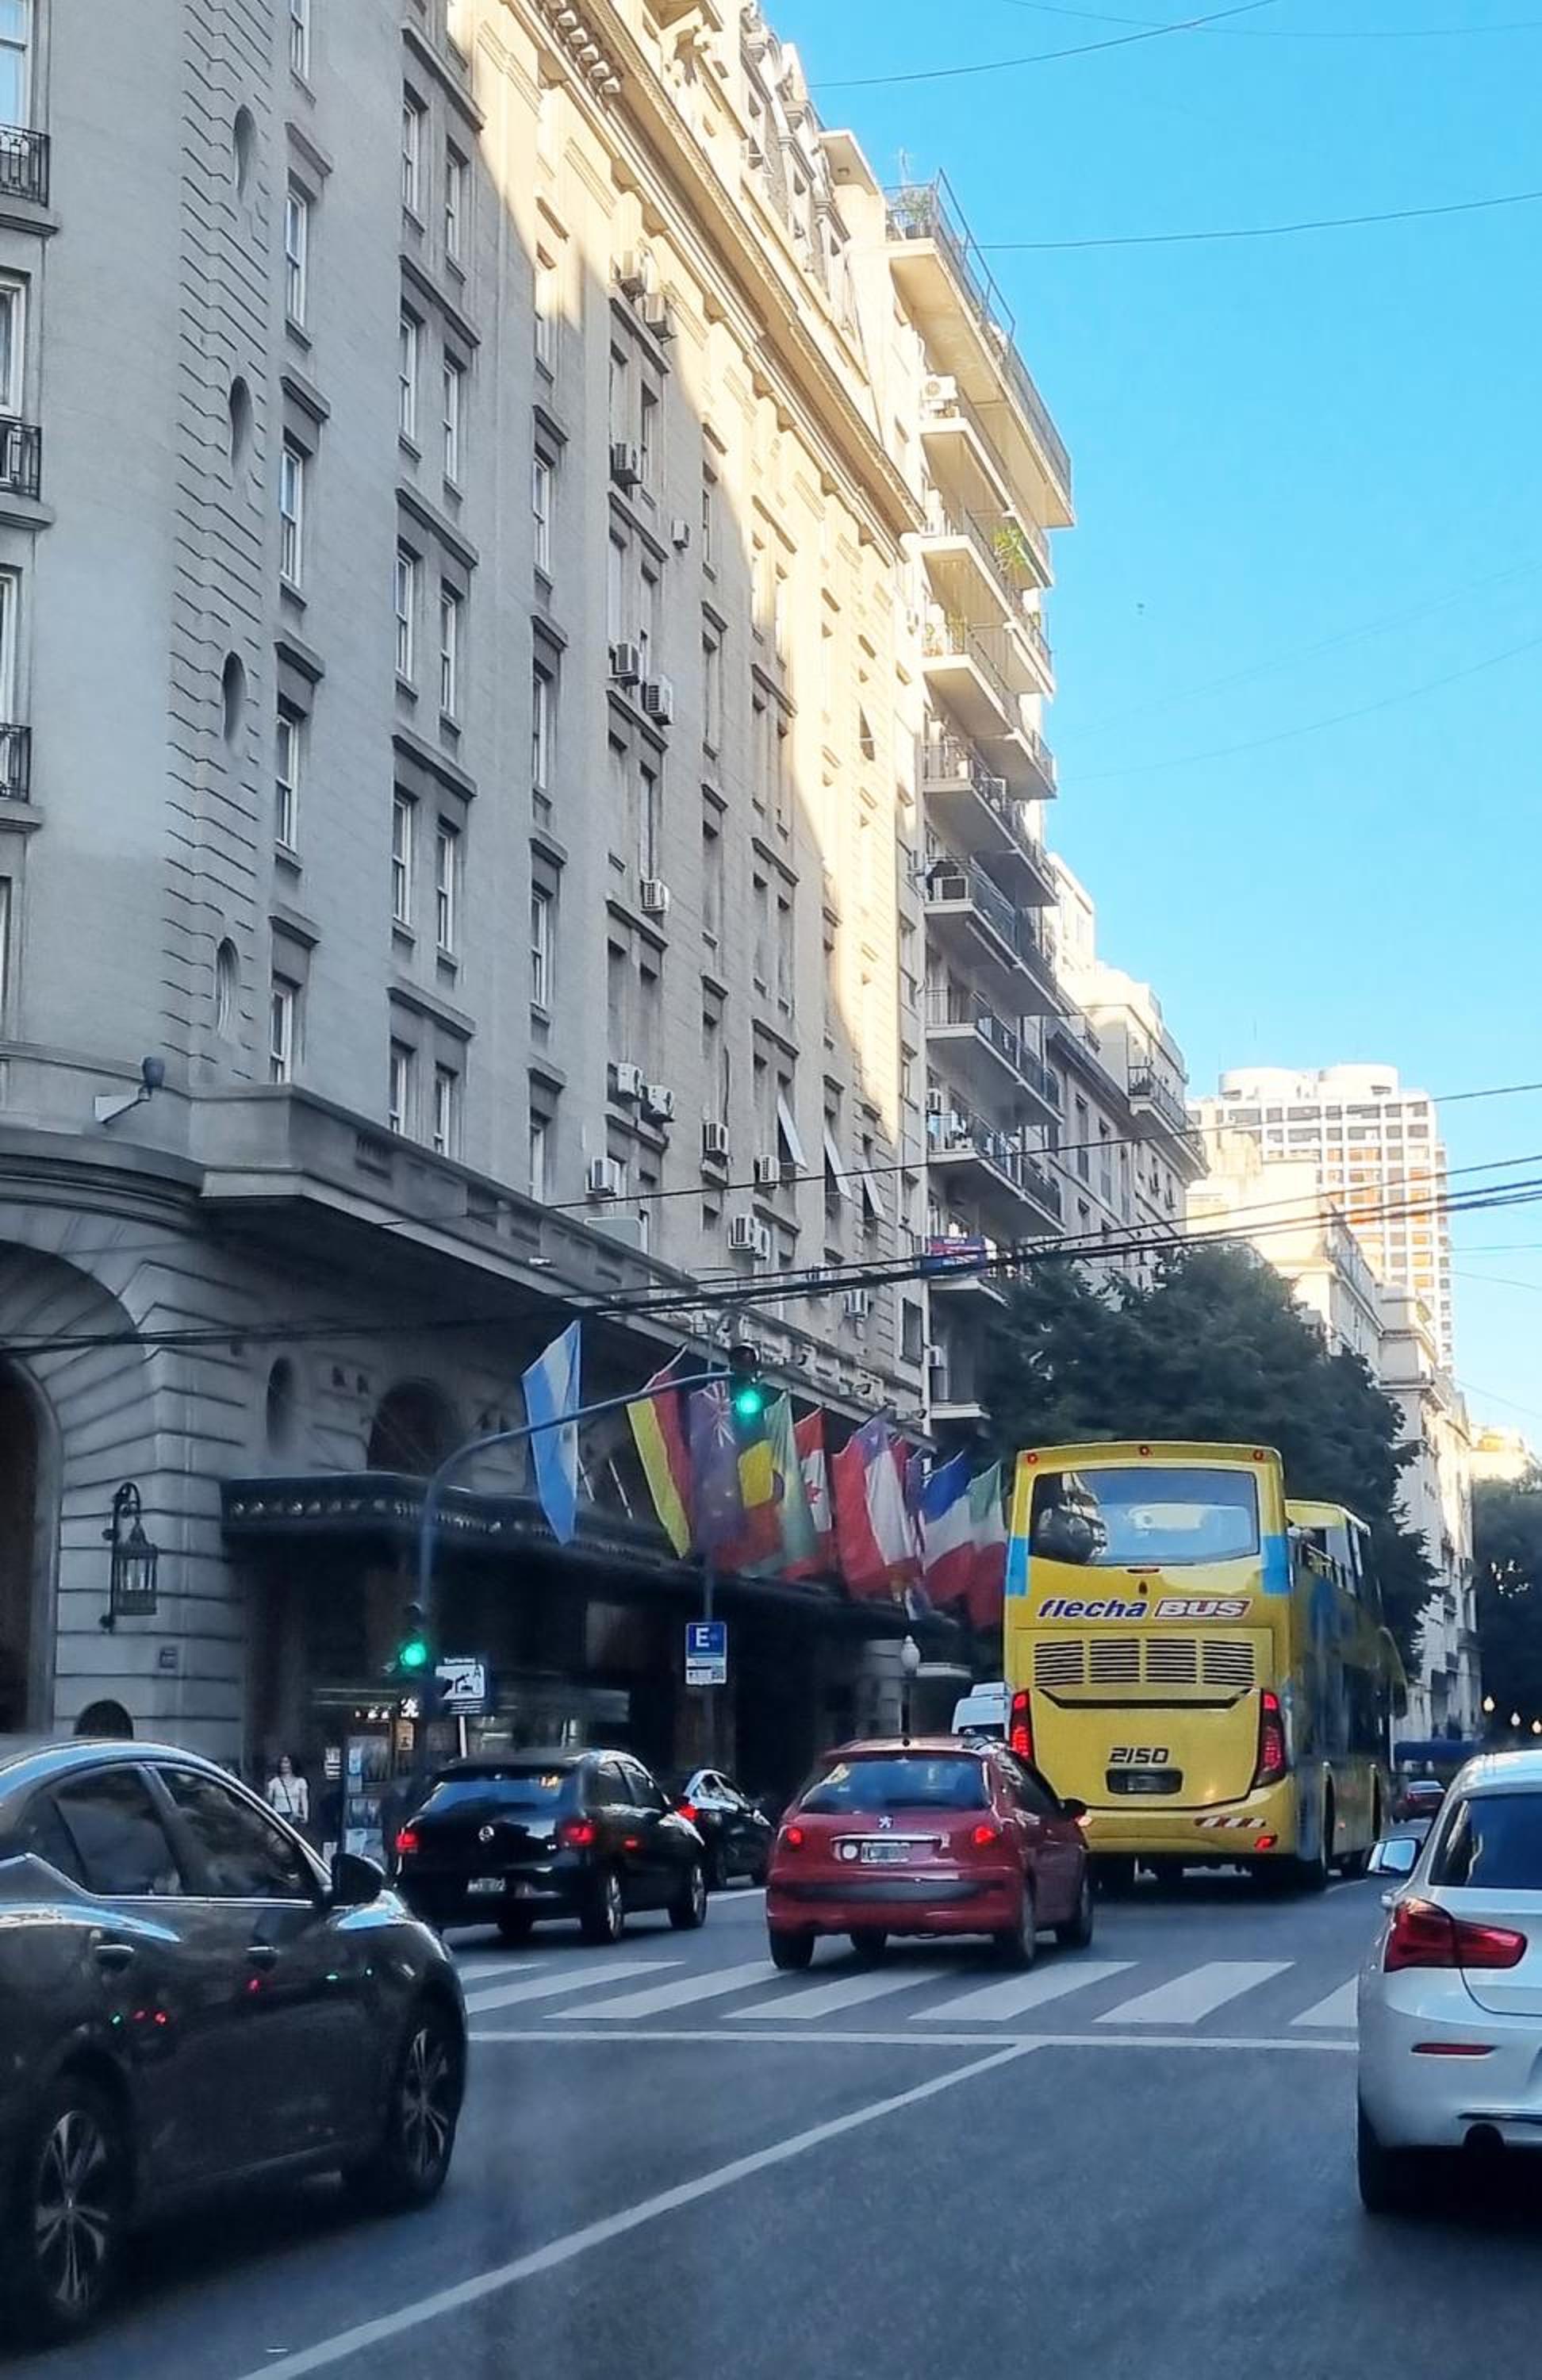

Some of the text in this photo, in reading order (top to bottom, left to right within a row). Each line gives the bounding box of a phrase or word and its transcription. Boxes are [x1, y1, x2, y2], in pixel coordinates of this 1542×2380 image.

[1038, 1599, 1246, 1618] flecha BUS
[696, 1626, 710, 1648] E
[1109, 1748, 1168, 1763] 2150
